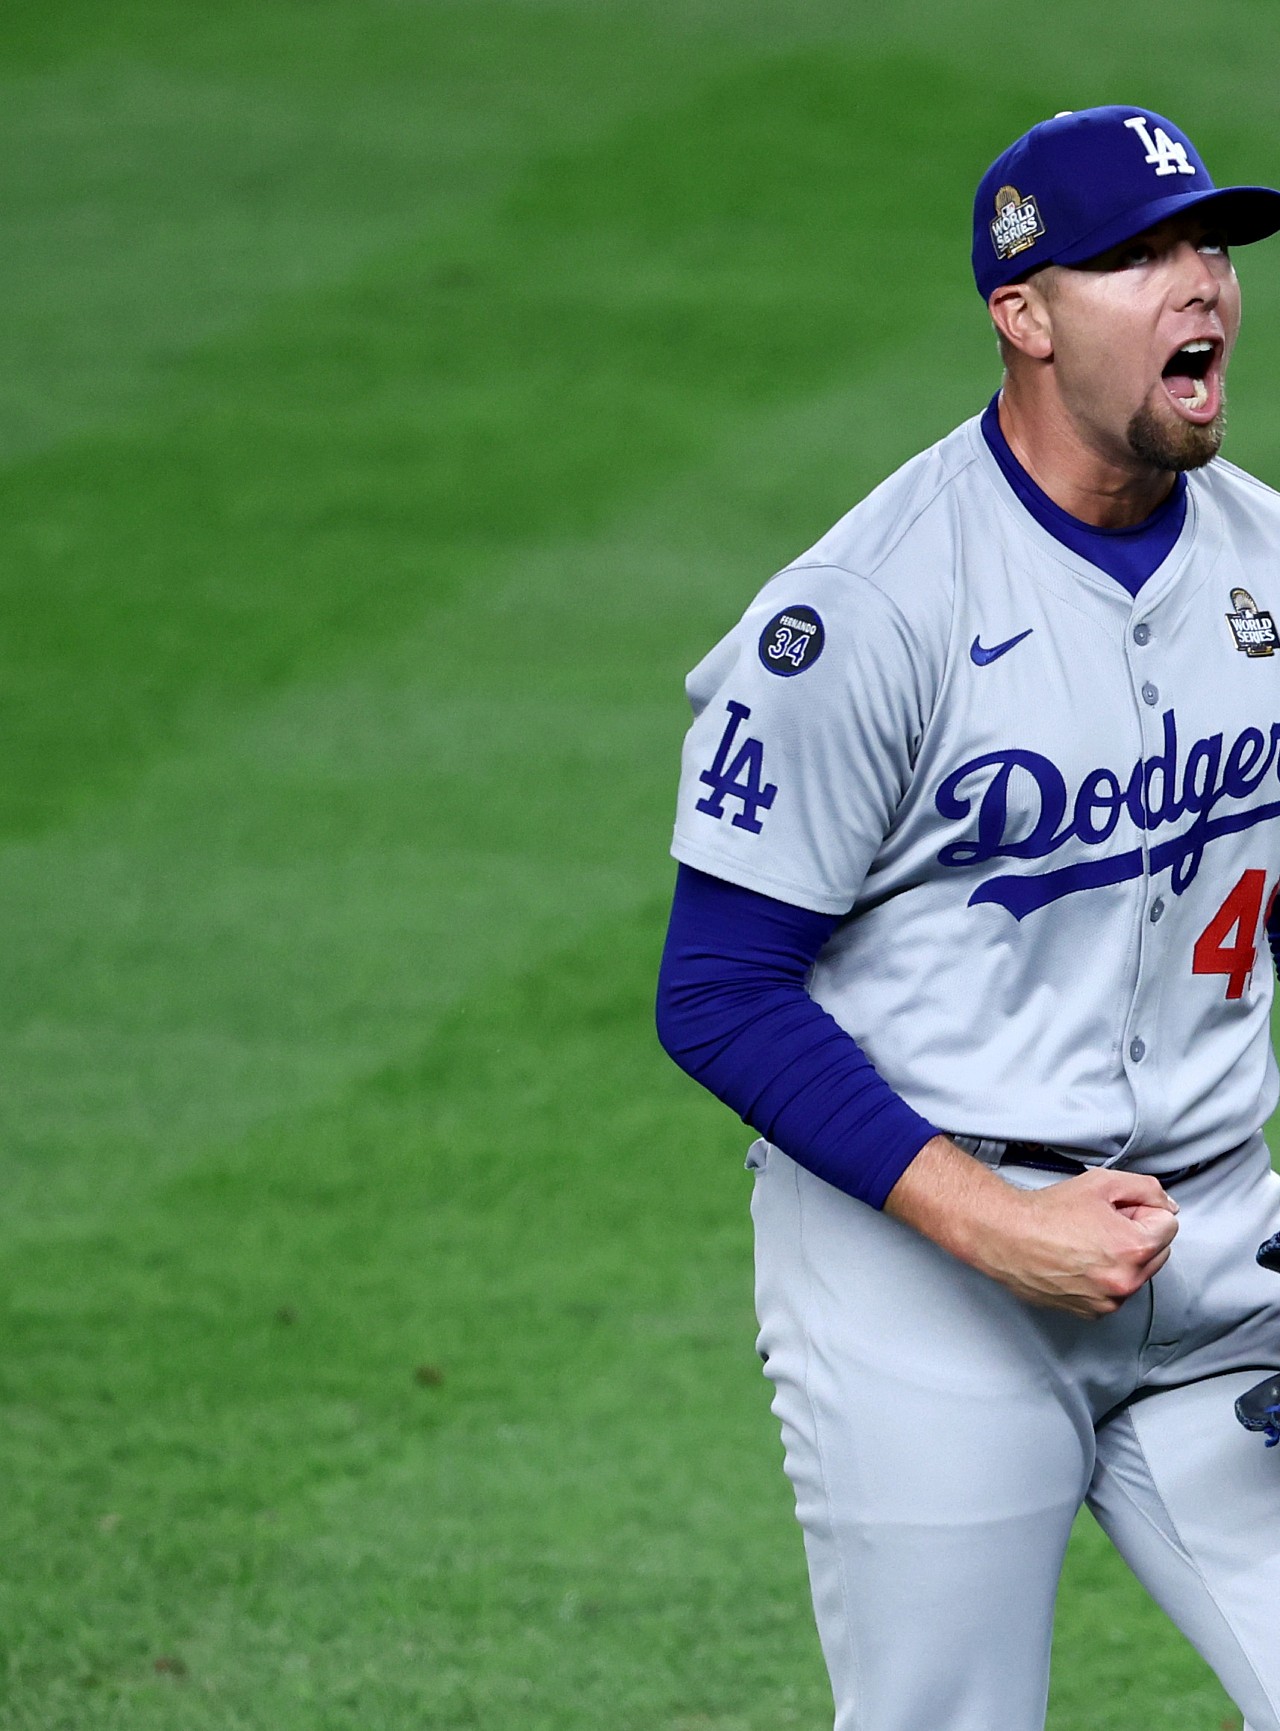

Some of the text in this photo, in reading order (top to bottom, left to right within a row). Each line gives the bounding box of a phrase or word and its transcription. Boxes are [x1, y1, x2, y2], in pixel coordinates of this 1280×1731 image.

[1123, 116, 1196, 177] LA
[991, 204, 1036, 237] WORLD
[996, 216, 1038, 249] SERIES
[779, 615, 817, 636] FERNANDO
[1230, 617, 1273, 631] WORLD
[1236, 629, 1276, 644] SERIES
[767, 627, 810, 667] 34
[695, 699, 779, 835] LA
